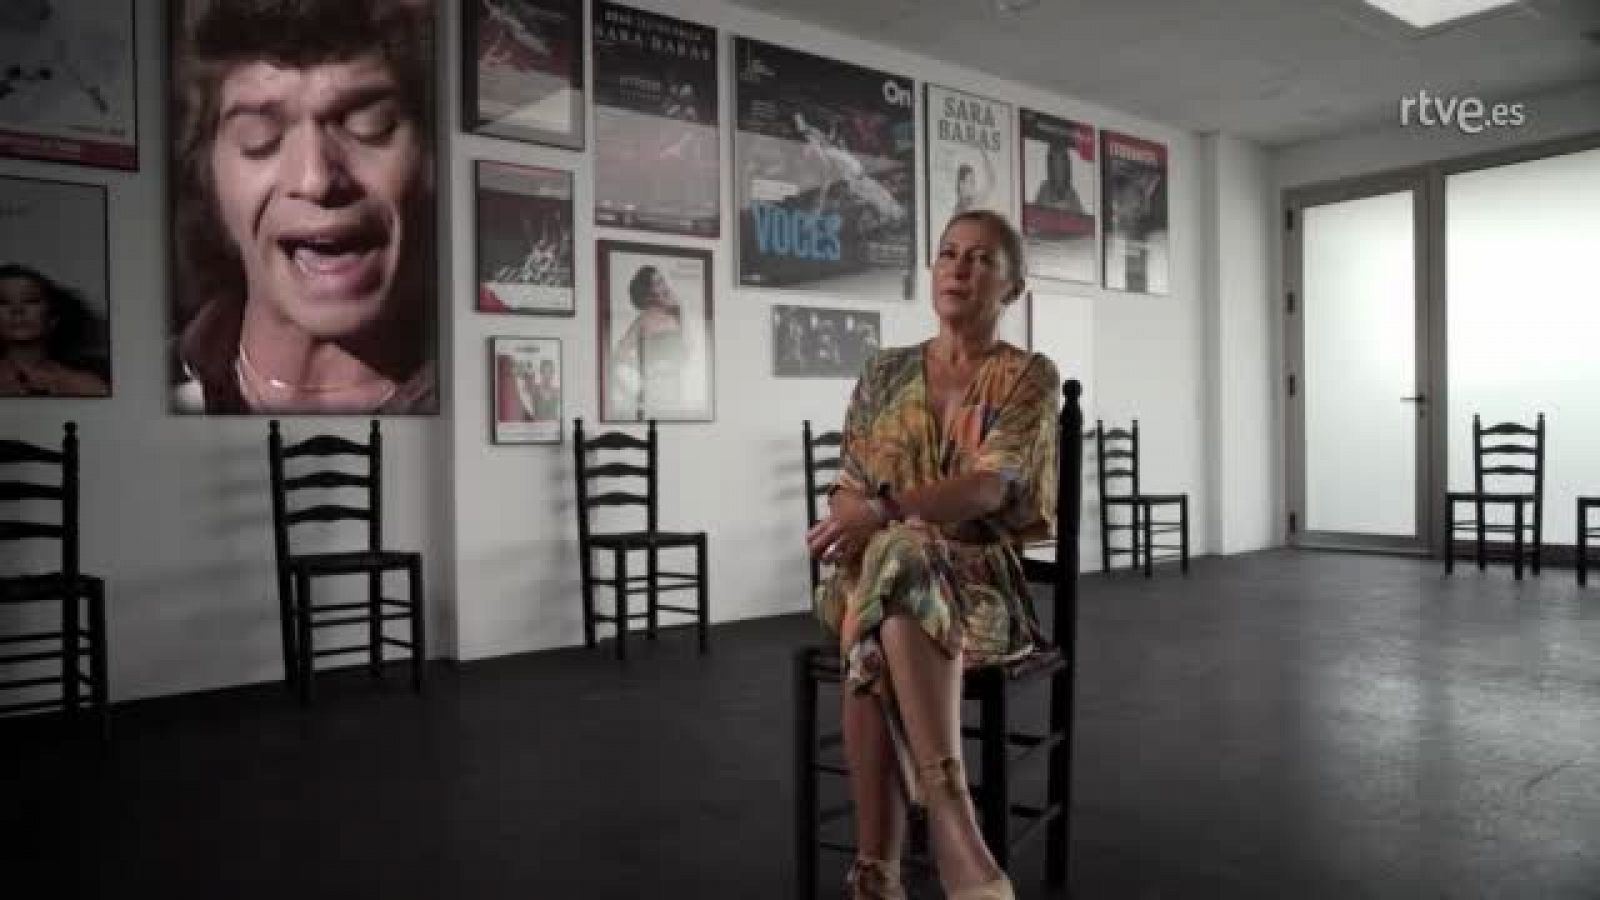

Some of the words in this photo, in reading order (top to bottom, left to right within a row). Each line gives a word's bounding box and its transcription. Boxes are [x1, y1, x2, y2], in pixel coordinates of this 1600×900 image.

[882, 80, 911, 107] On
[943, 96, 996, 127] SARA
[938, 119, 1001, 151] BARAS
[753, 203, 842, 262] VOCES
